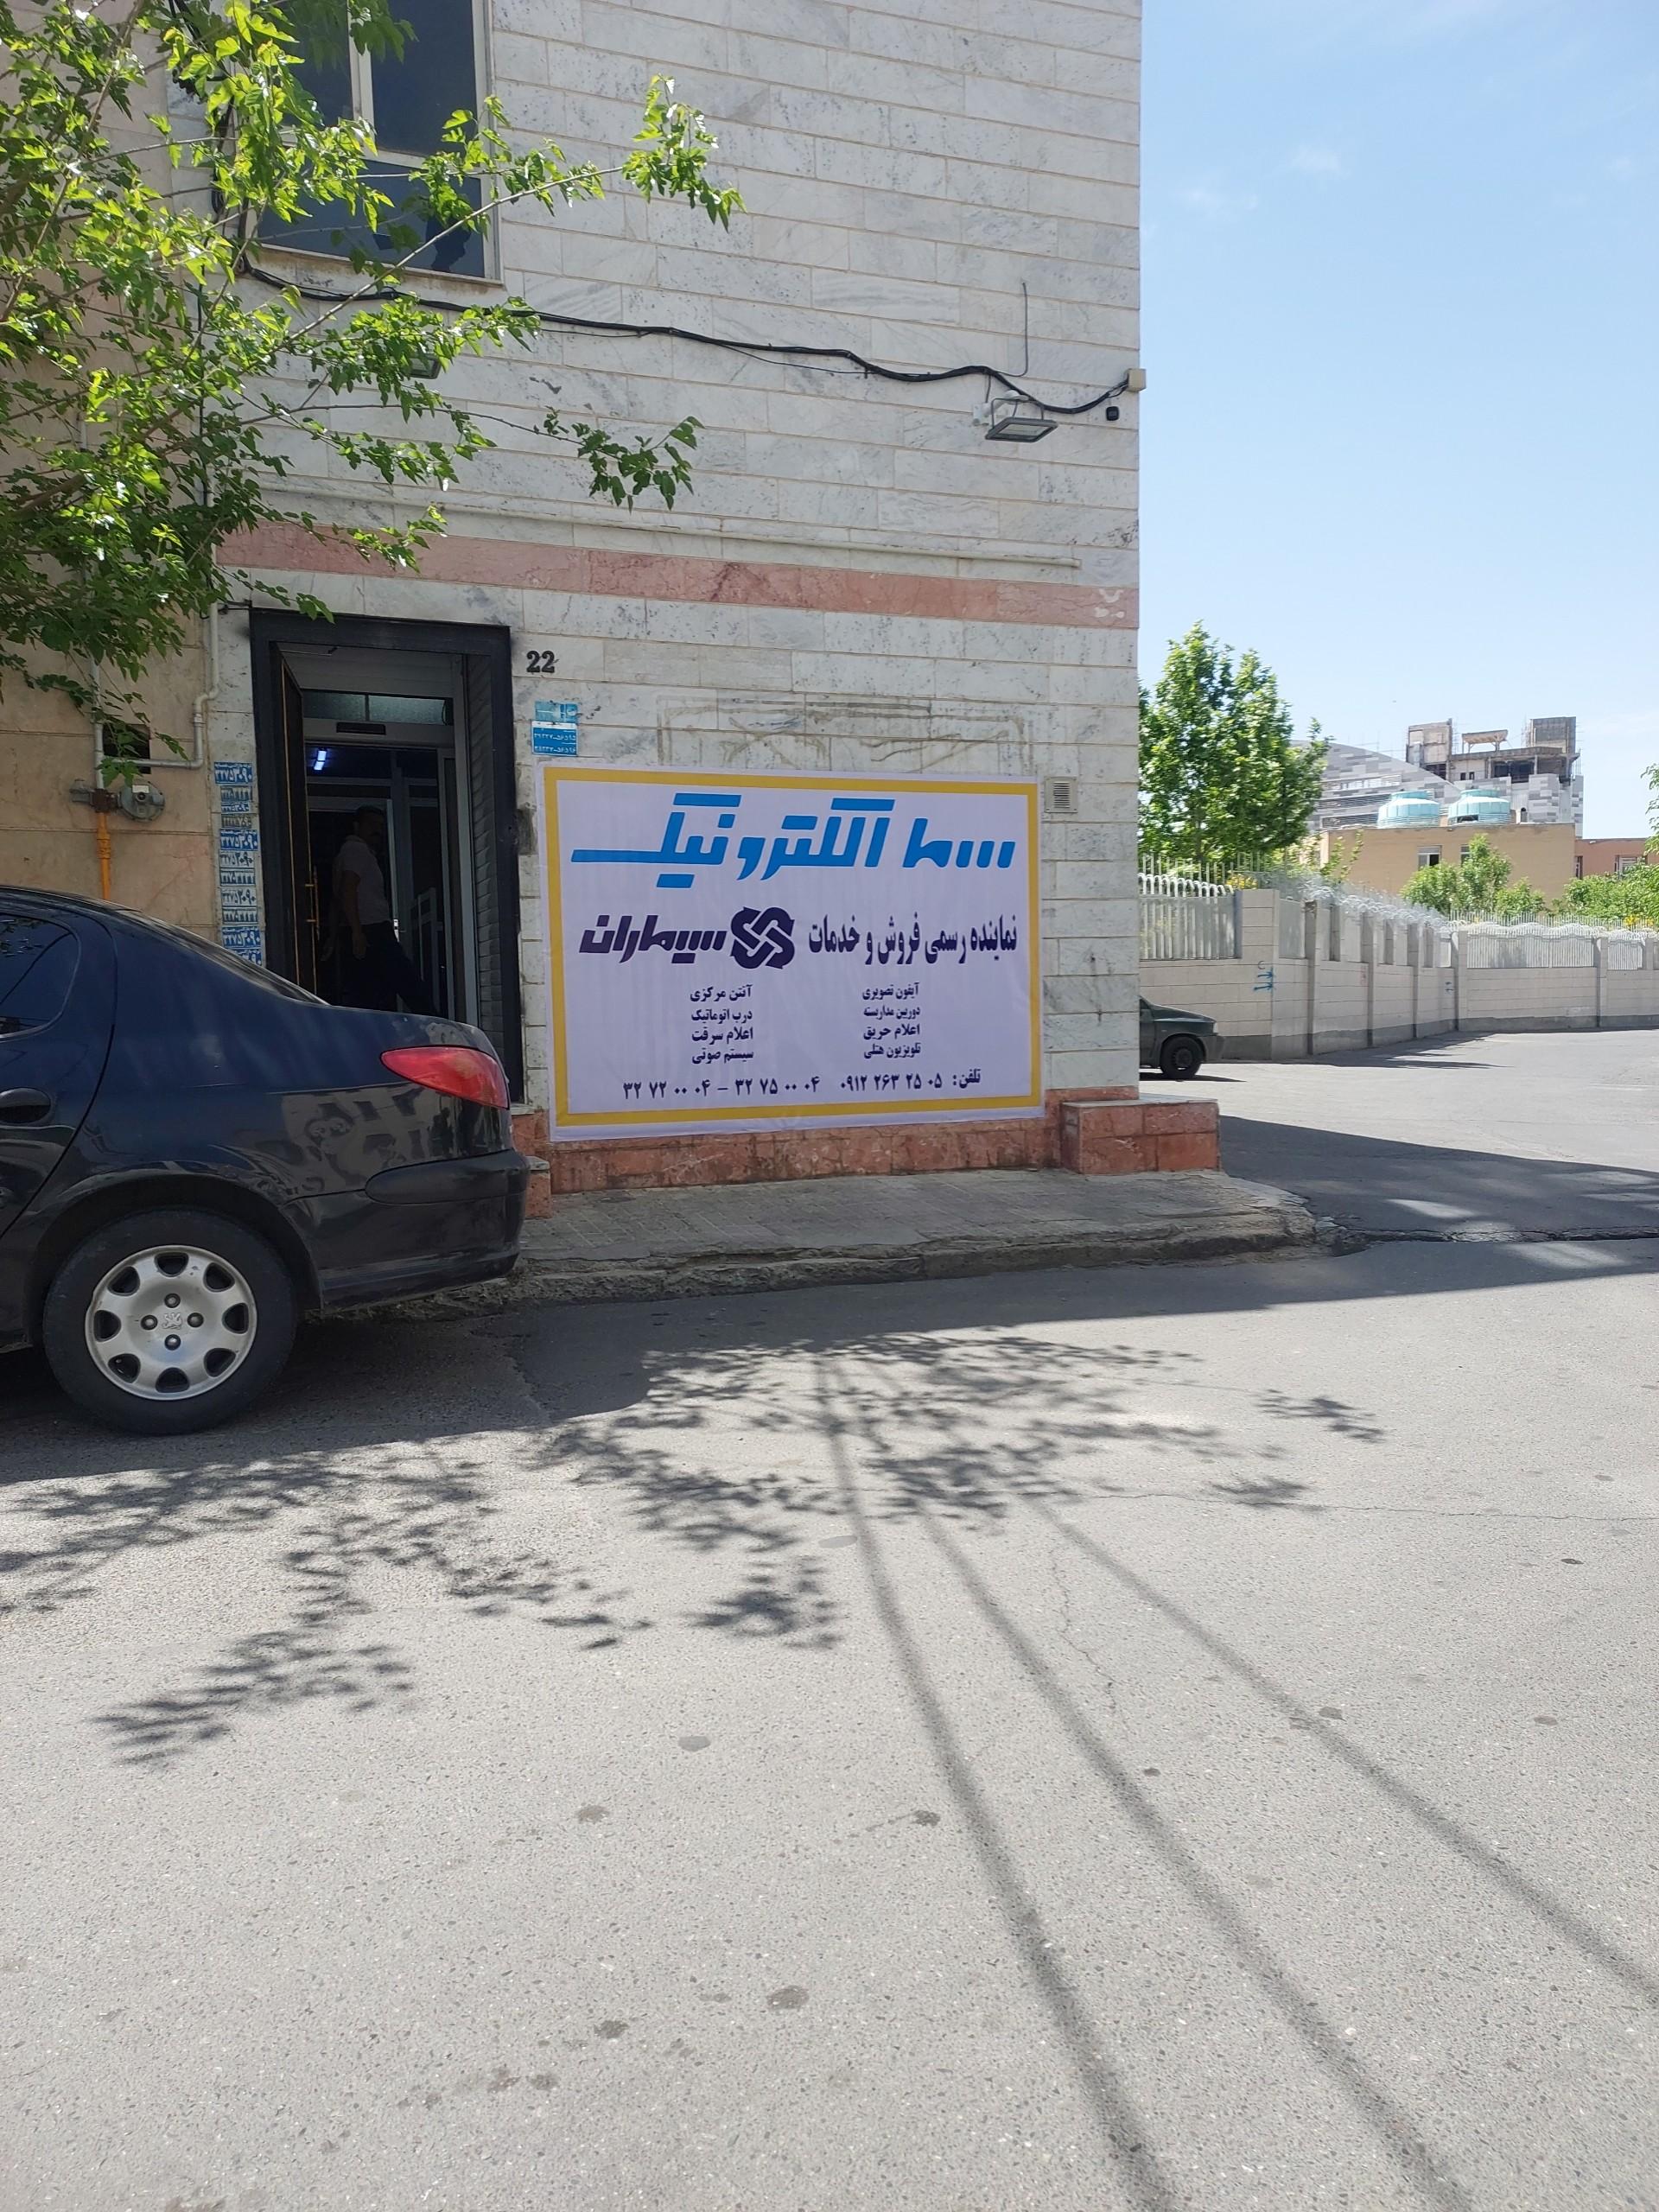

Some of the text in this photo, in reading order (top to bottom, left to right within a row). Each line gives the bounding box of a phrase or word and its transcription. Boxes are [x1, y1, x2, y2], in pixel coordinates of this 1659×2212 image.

[526, 651, 556, 673] 22
[571, 792, 896, 890] الکترونیک
[579, 914, 728, 965] سیماران
[808, 912, 1017, 966] نماینده رسمی فروش و خدمات
[690, 983, 753, 1002] آنتن مرکزی
[862, 982, 920, 1001] آیفون تصویری
[690, 1007, 753, 1025] درب اتوماتیک
[896, 1007, 921, 1020] دوربین
[691, 1026, 753, 1046] اعلام سرقت
[863, 1023, 920, 1040] اعلام حریق
[691, 1047, 754, 1065] سیستم صوتی
[863, 1042, 922, 1059] تلویزیون هتلی
[694, 1078, 711, 1097] ۰۴
[734, 1077, 753, 1096] ۳۲
[759, 1077, 779, 1096] ۷۵
[804, 1075, 821, 1093] ۰۴
[840, 1074, 868, 1092] ۰۹۱۲
[873, 1073, 900, 1091] ۲۶۳
[905, 1072, 922, 1090] ۲۵
[927, 1072, 943, 1090] ۰۵
[622, 1082, 642, 1100] ۳۲
[648, 1081, 667, 1100] ۷۲
